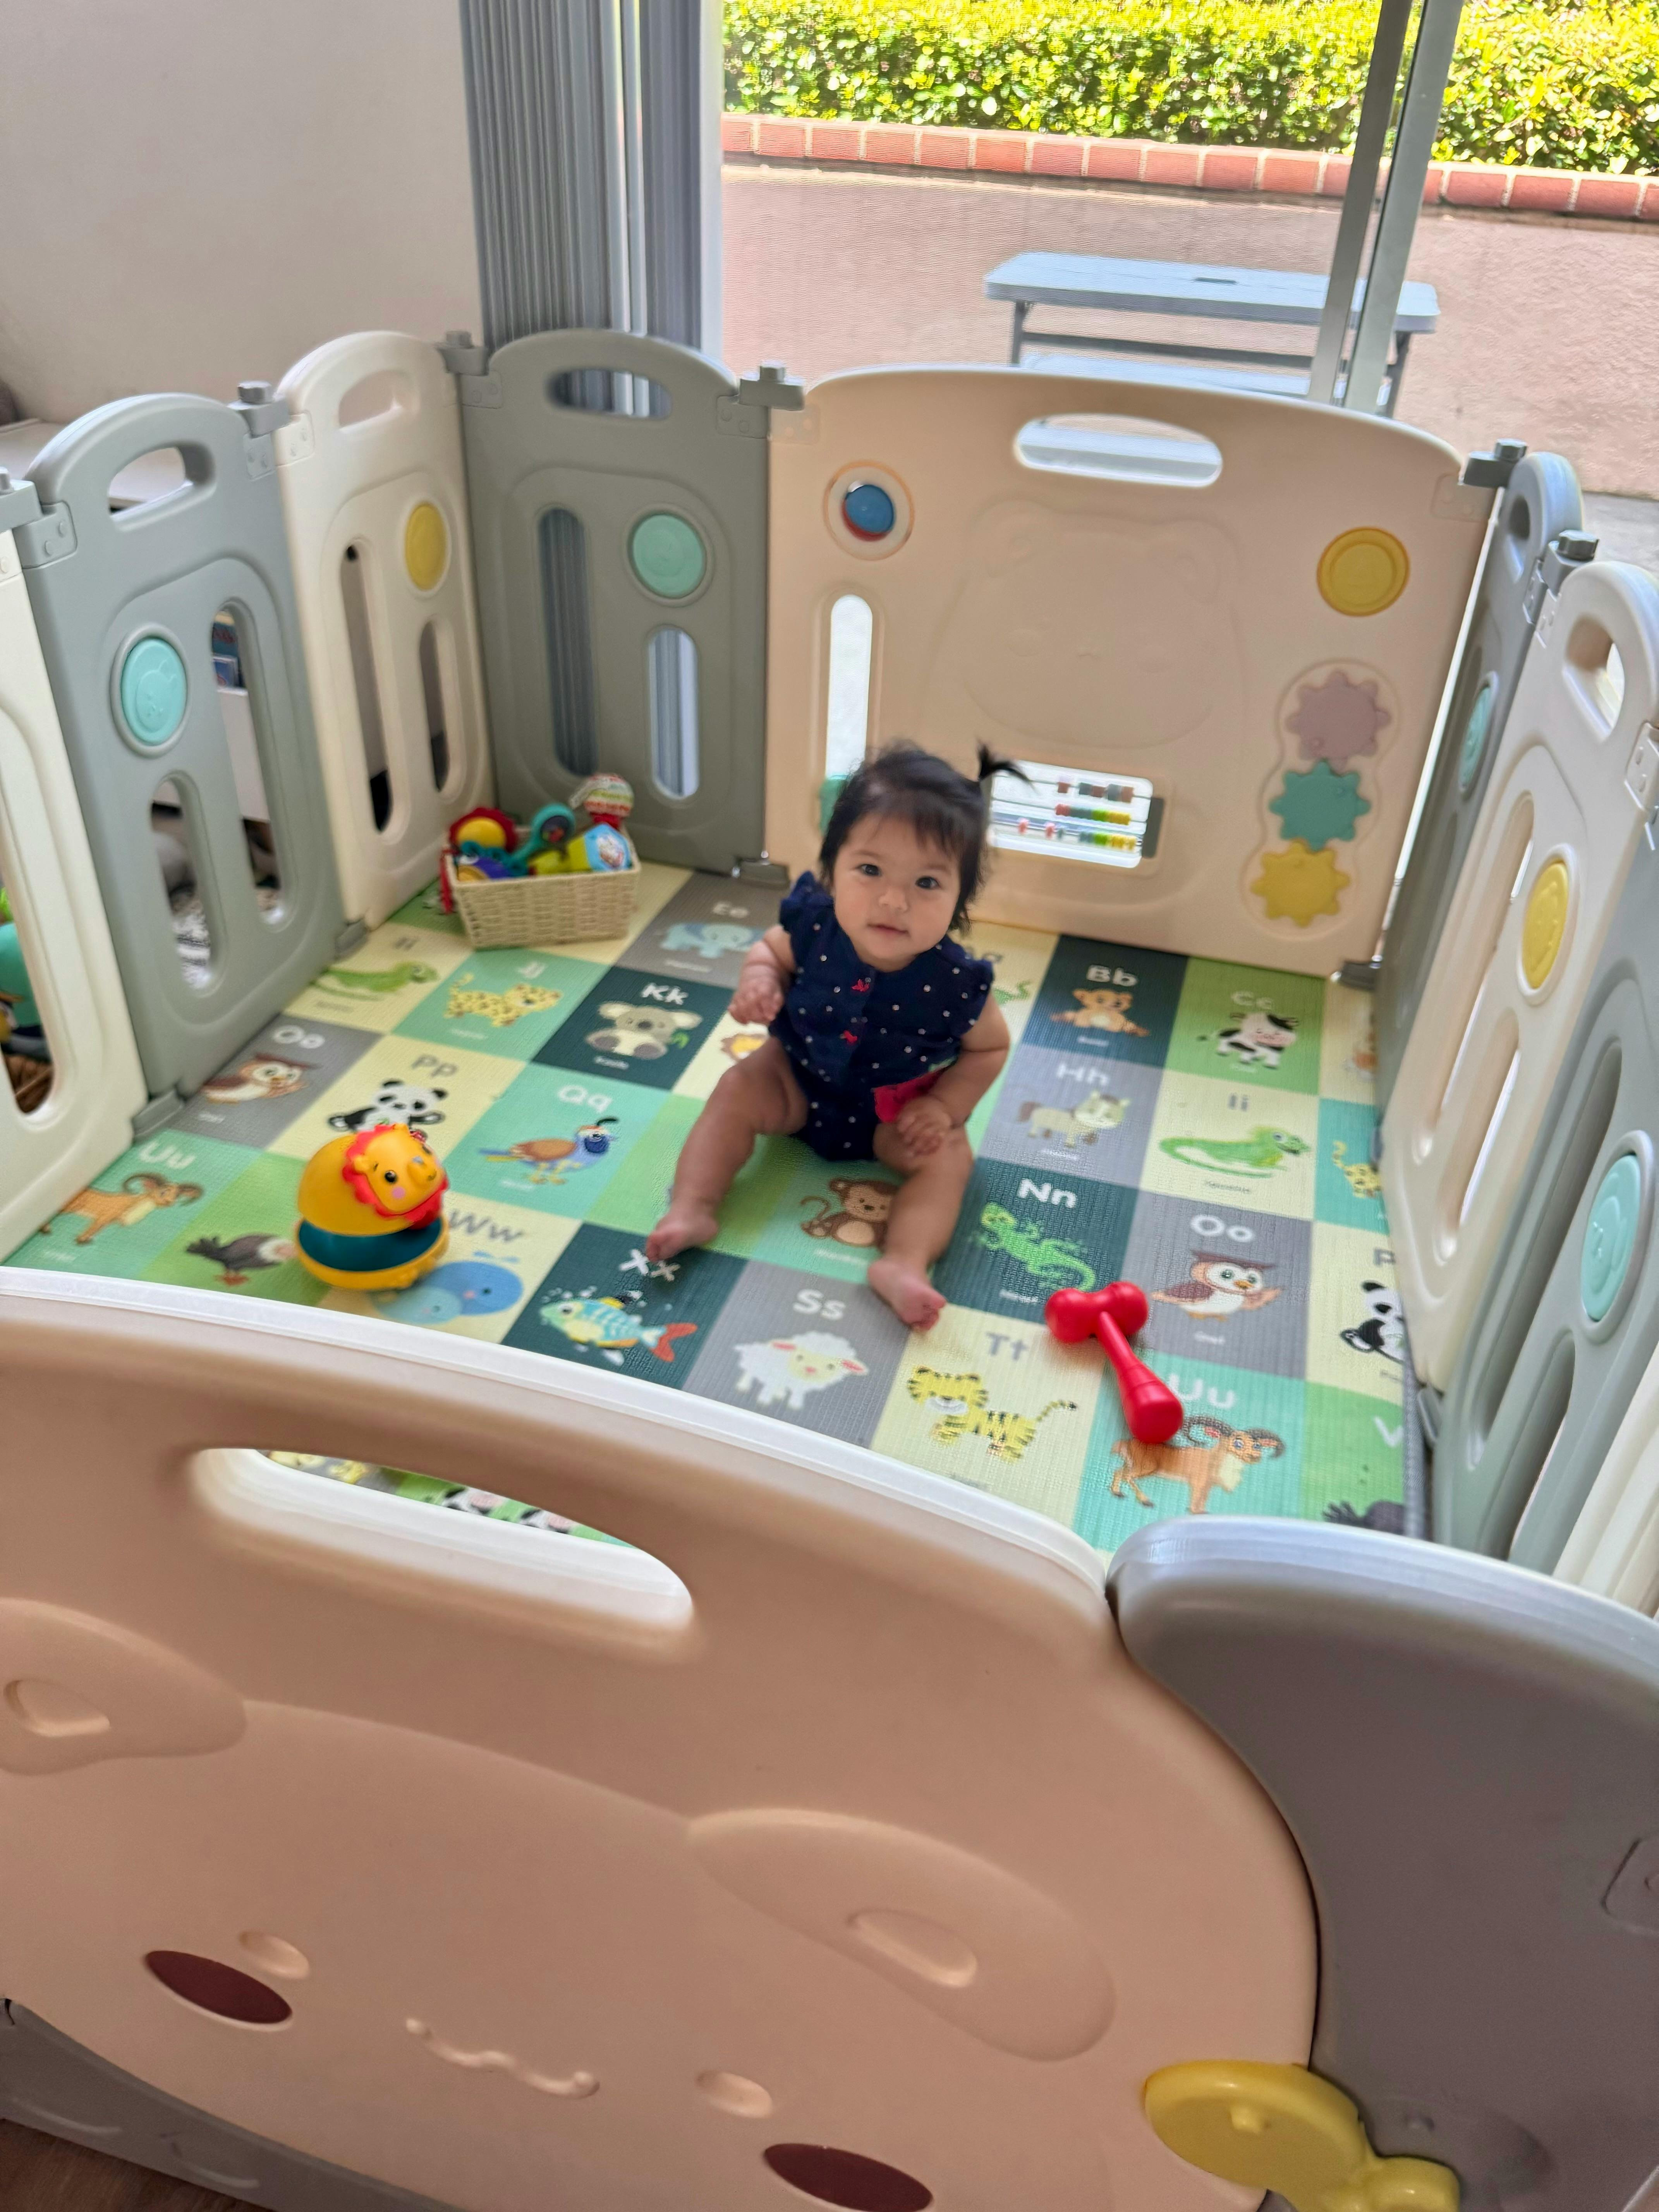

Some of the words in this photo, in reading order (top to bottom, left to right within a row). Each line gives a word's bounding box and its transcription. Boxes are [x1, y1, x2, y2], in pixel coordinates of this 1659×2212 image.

[1086, 964, 1138, 987] Bb
[641, 982, 689, 1005] Kk
[271, 1025, 325, 1048] Oo
[412, 1053, 458, 1077] Pp
[1057, 1063, 1109, 1085] Hh
[558, 1085, 613, 1113] Qq
[140, 1140, 194, 1168] Uu
[1017, 1178, 1077, 1208] Nn
[449, 1209, 524, 1242] Ww
[1191, 1214, 1255, 1242] Oo
[620, 1249, 680, 1281] Xx
[793, 1289, 846, 1321] Ss
[986, 1332, 1029, 1360] Tt
[1169, 1374, 1235, 1408] Uu
